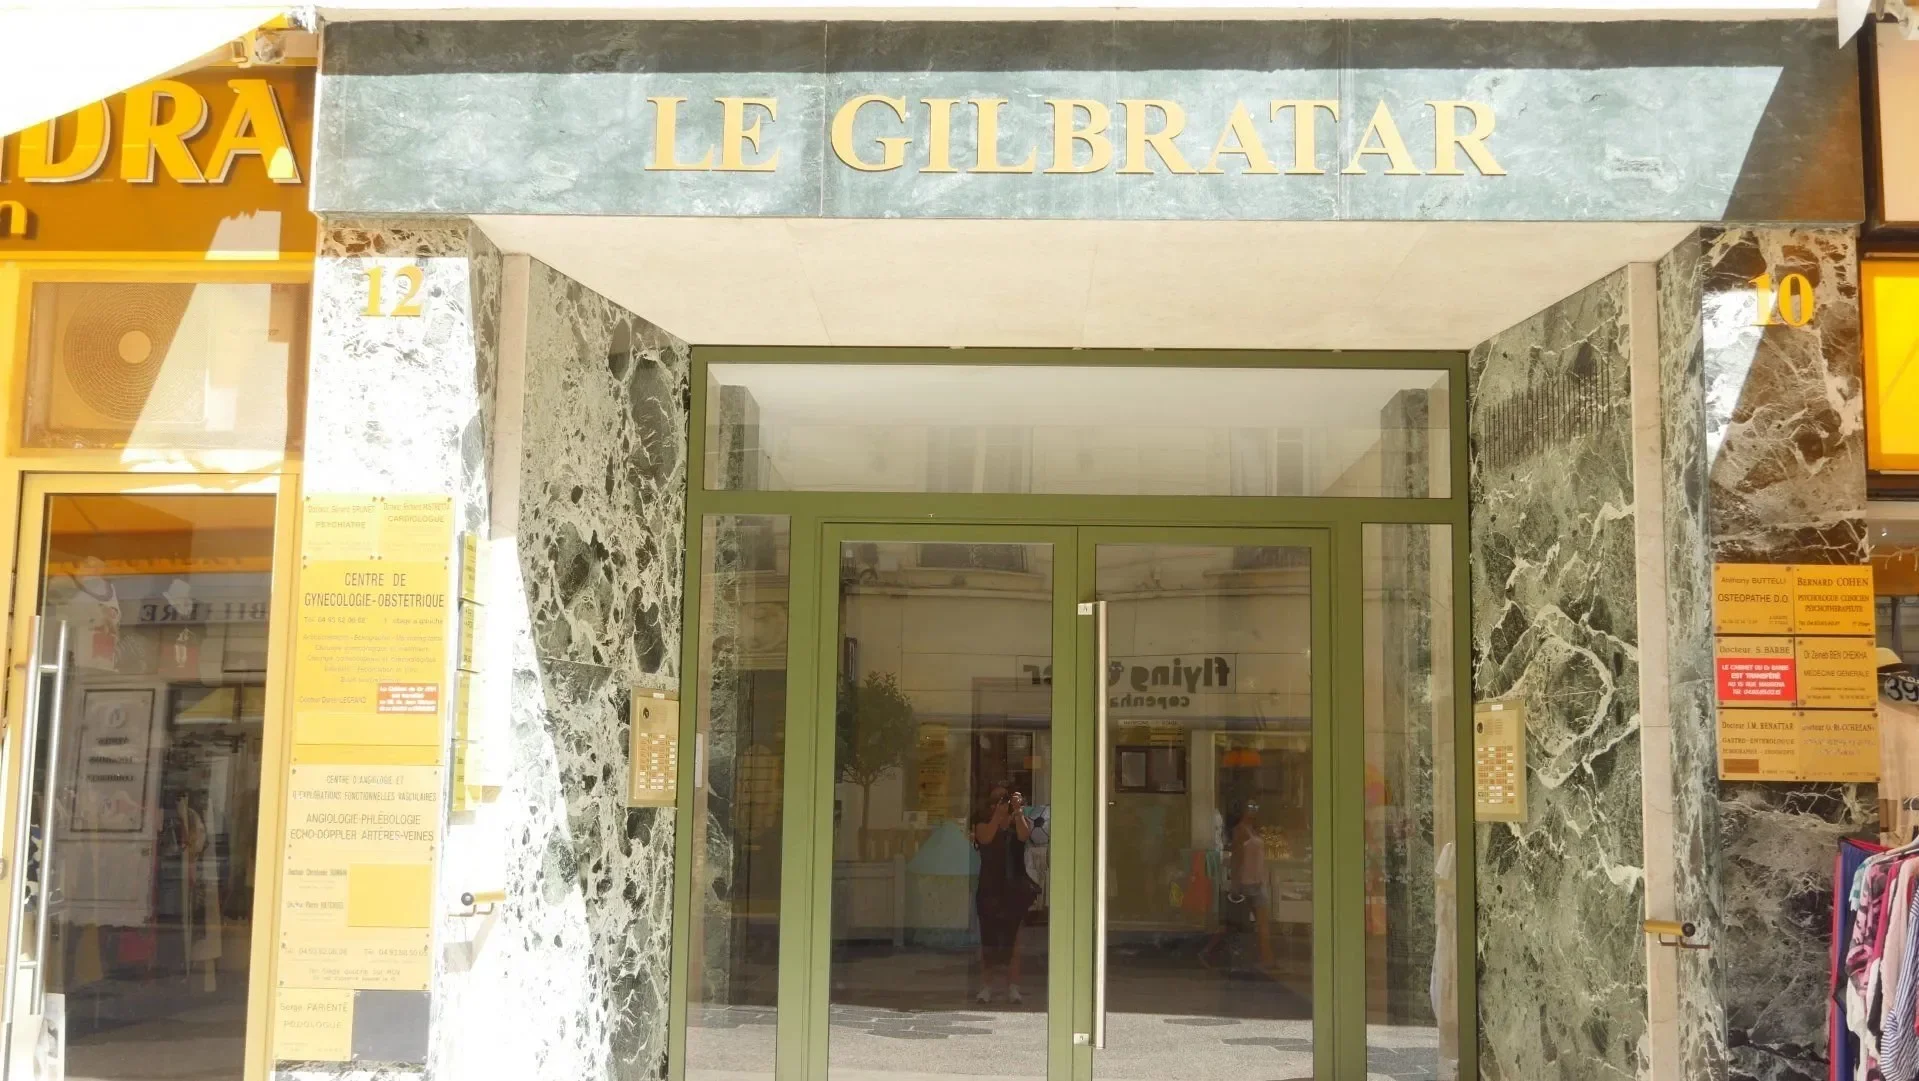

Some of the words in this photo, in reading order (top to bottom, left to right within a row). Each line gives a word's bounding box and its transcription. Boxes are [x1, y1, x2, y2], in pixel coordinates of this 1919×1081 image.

[0, 79, 302, 184] DRA
[644, 96, 781, 173] LE
[830, 94, 1507, 176] GILBRATAR
[361, 264, 424, 317] 12
[1748, 273, 1815, 327] 10
[387, 515, 445, 523] CARDIOLOGUE
[315, 520, 367, 529] PSYCHIATRE
[344, 572, 384, 587] CENTRE
[393, 572, 406, 587] DE
[1836, 577, 1869, 587] COHEN
[1717, 593, 1772, 603] OSTEOPATHE
[1719, 646, 1750, 654] Docteur
[1763, 646, 1790, 654] BARBE
[1721, 721, 1745, 729] Docteur
[326, 775, 350, 785] CENTRE
[344, 791, 396, 802] FONCTIONNELLES
[398, 791, 437, 803] VASCULAIRES
[279, 1003, 303, 1013] Serge
[306, 1001, 349, 1013] PARIENTE
[283, 1020, 344, 1030] PODOLOGUE
